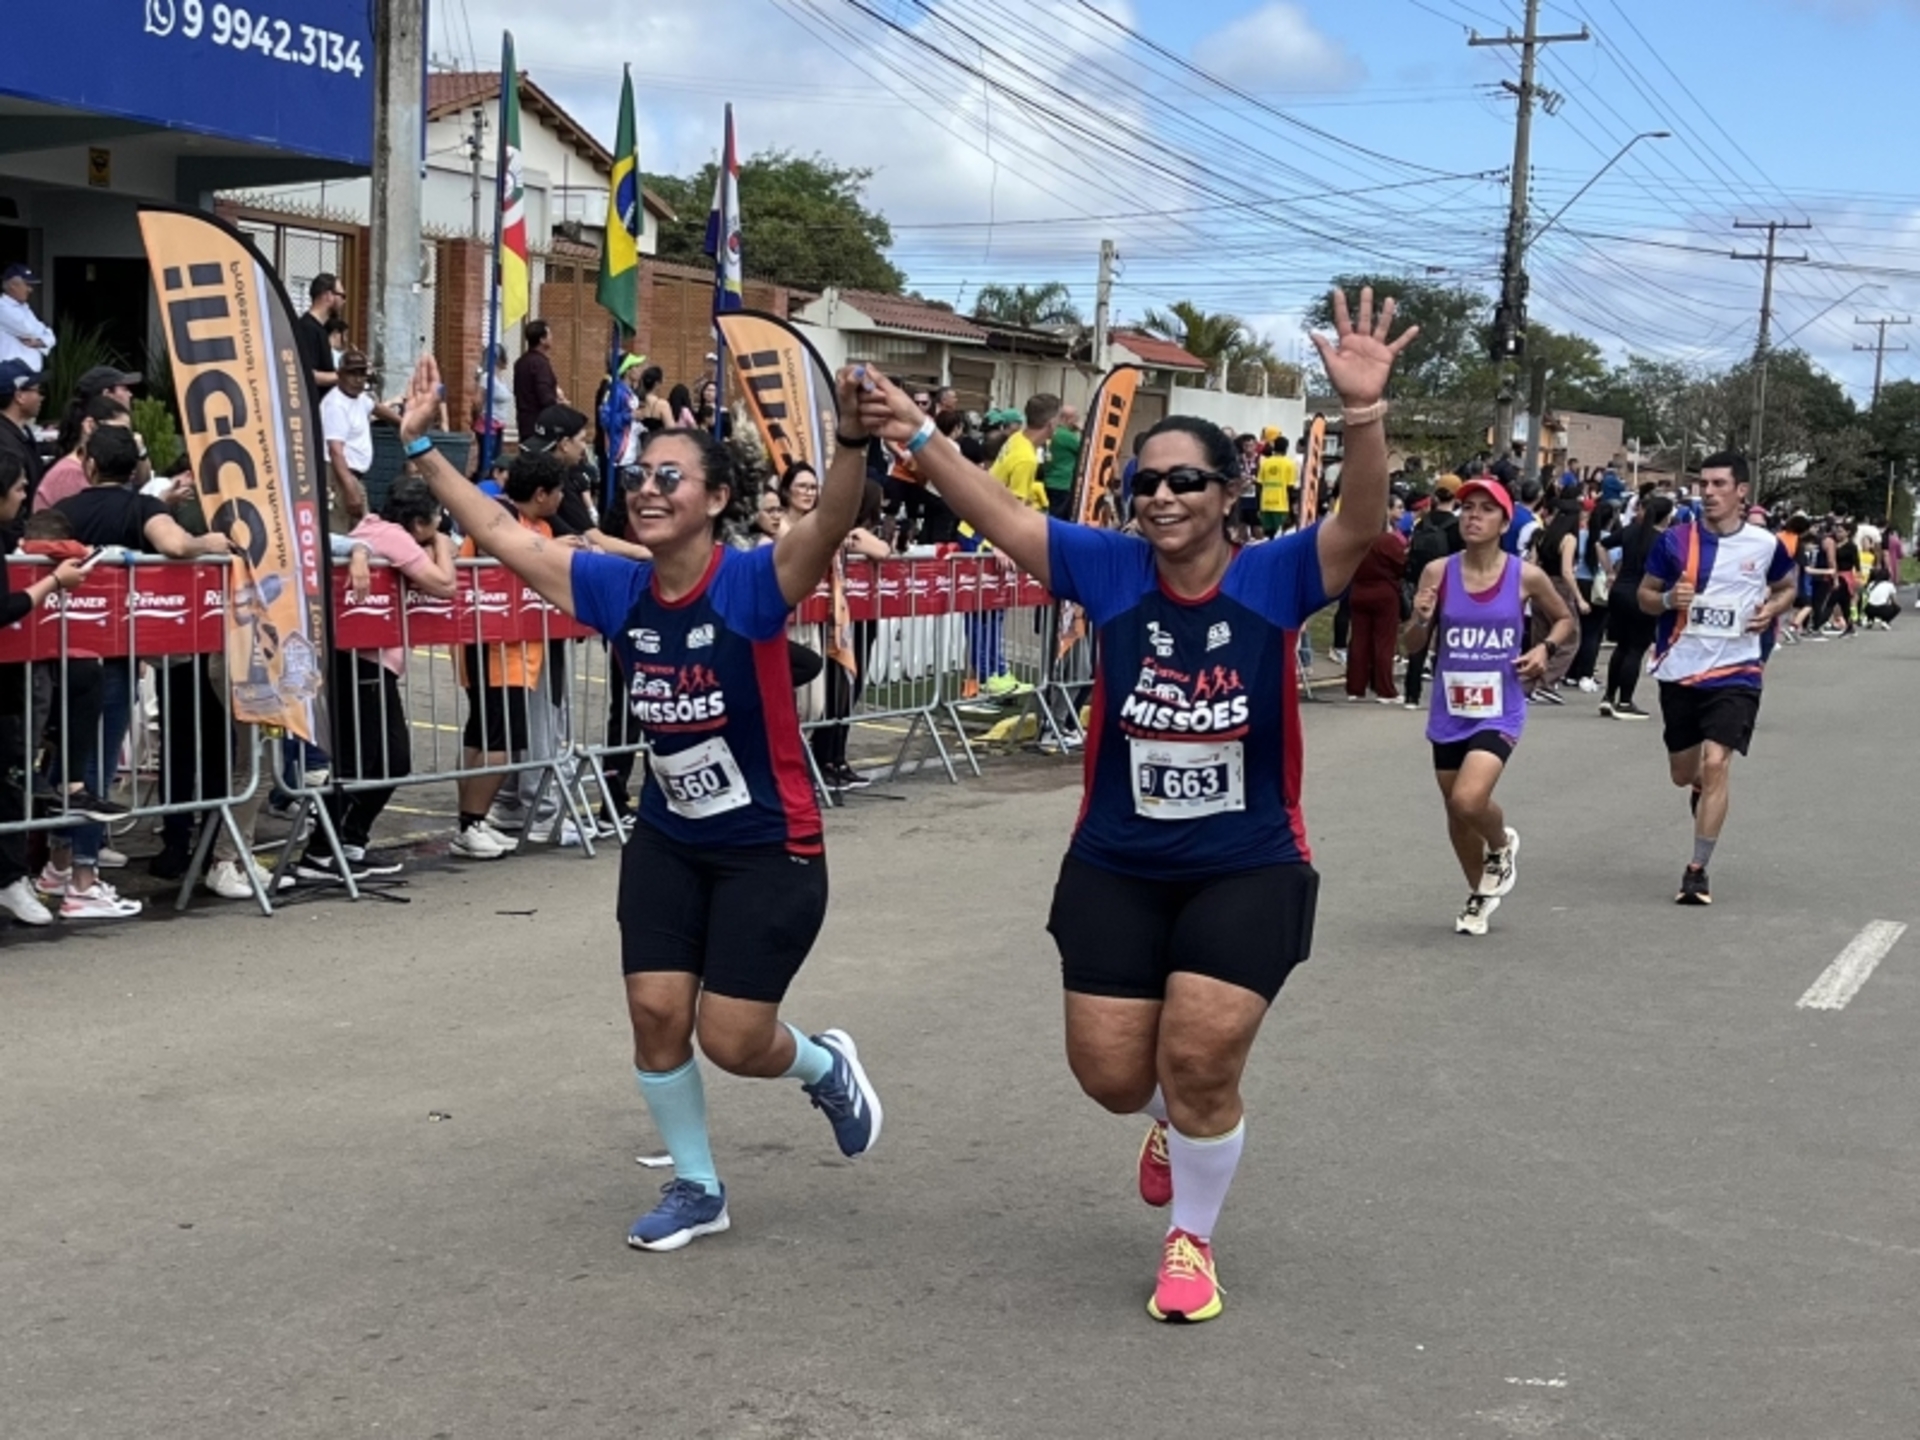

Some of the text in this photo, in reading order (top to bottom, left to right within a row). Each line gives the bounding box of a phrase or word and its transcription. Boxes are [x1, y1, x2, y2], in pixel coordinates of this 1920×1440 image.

[182, 0, 364, 78] 9 9942.3134
[1446, 626, 1515, 650] GUIAR
[630, 690, 725, 723] MISSÕES
[1120, 693, 1249, 732] MISSÕES
[669, 767, 721, 800] 560
[1163, 767, 1220, 798] 663
